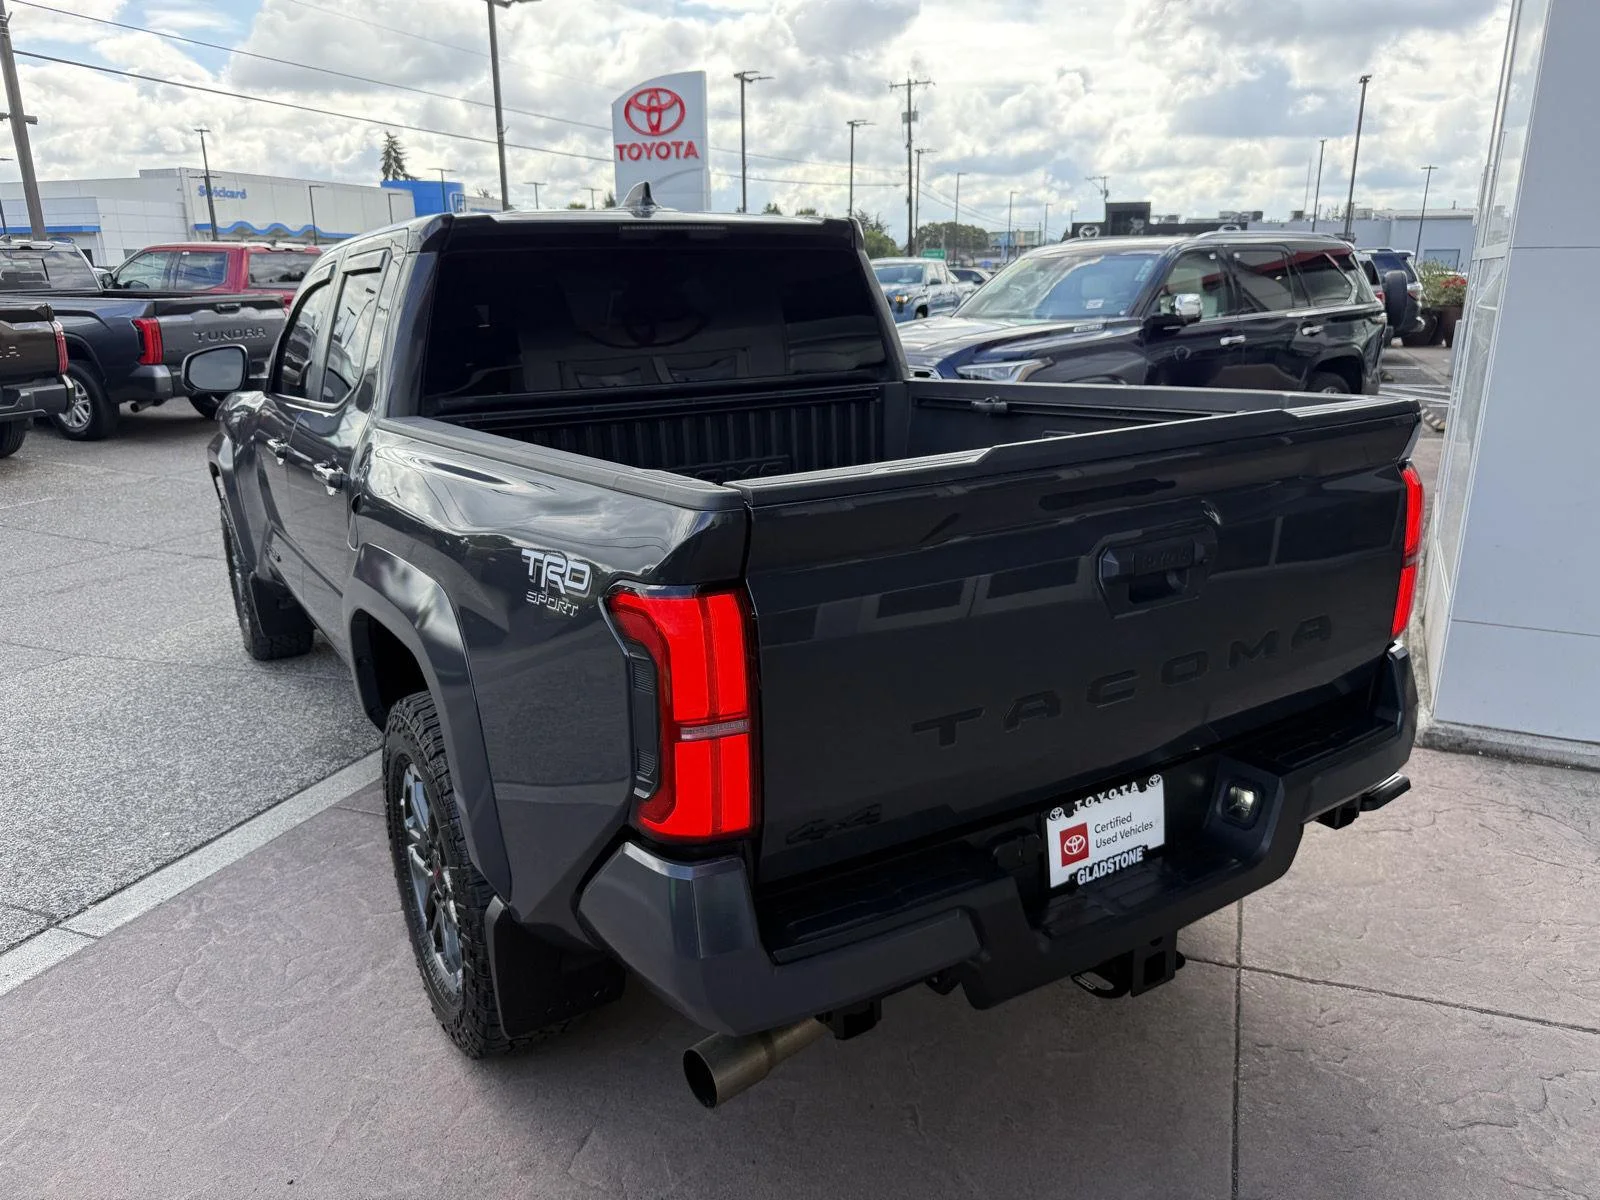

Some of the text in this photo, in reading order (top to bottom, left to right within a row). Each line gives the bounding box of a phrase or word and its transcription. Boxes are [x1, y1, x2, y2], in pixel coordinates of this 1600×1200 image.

[616, 141, 699, 161] TOYOTA
[198, 184, 247, 199] Sickard
[192, 327, 267, 343] TUNDRA
[521, 548, 591, 597] TRD
[526, 590, 579, 617] SPORT
[911, 614, 1332, 748] TACOMA
[1074, 781, 1140, 812] TOYOTA
[1094, 812, 1132, 834] Certified
[1095, 821, 1153, 849] Used Vehicles
[1077, 846, 1143, 885] GLADSTONE
